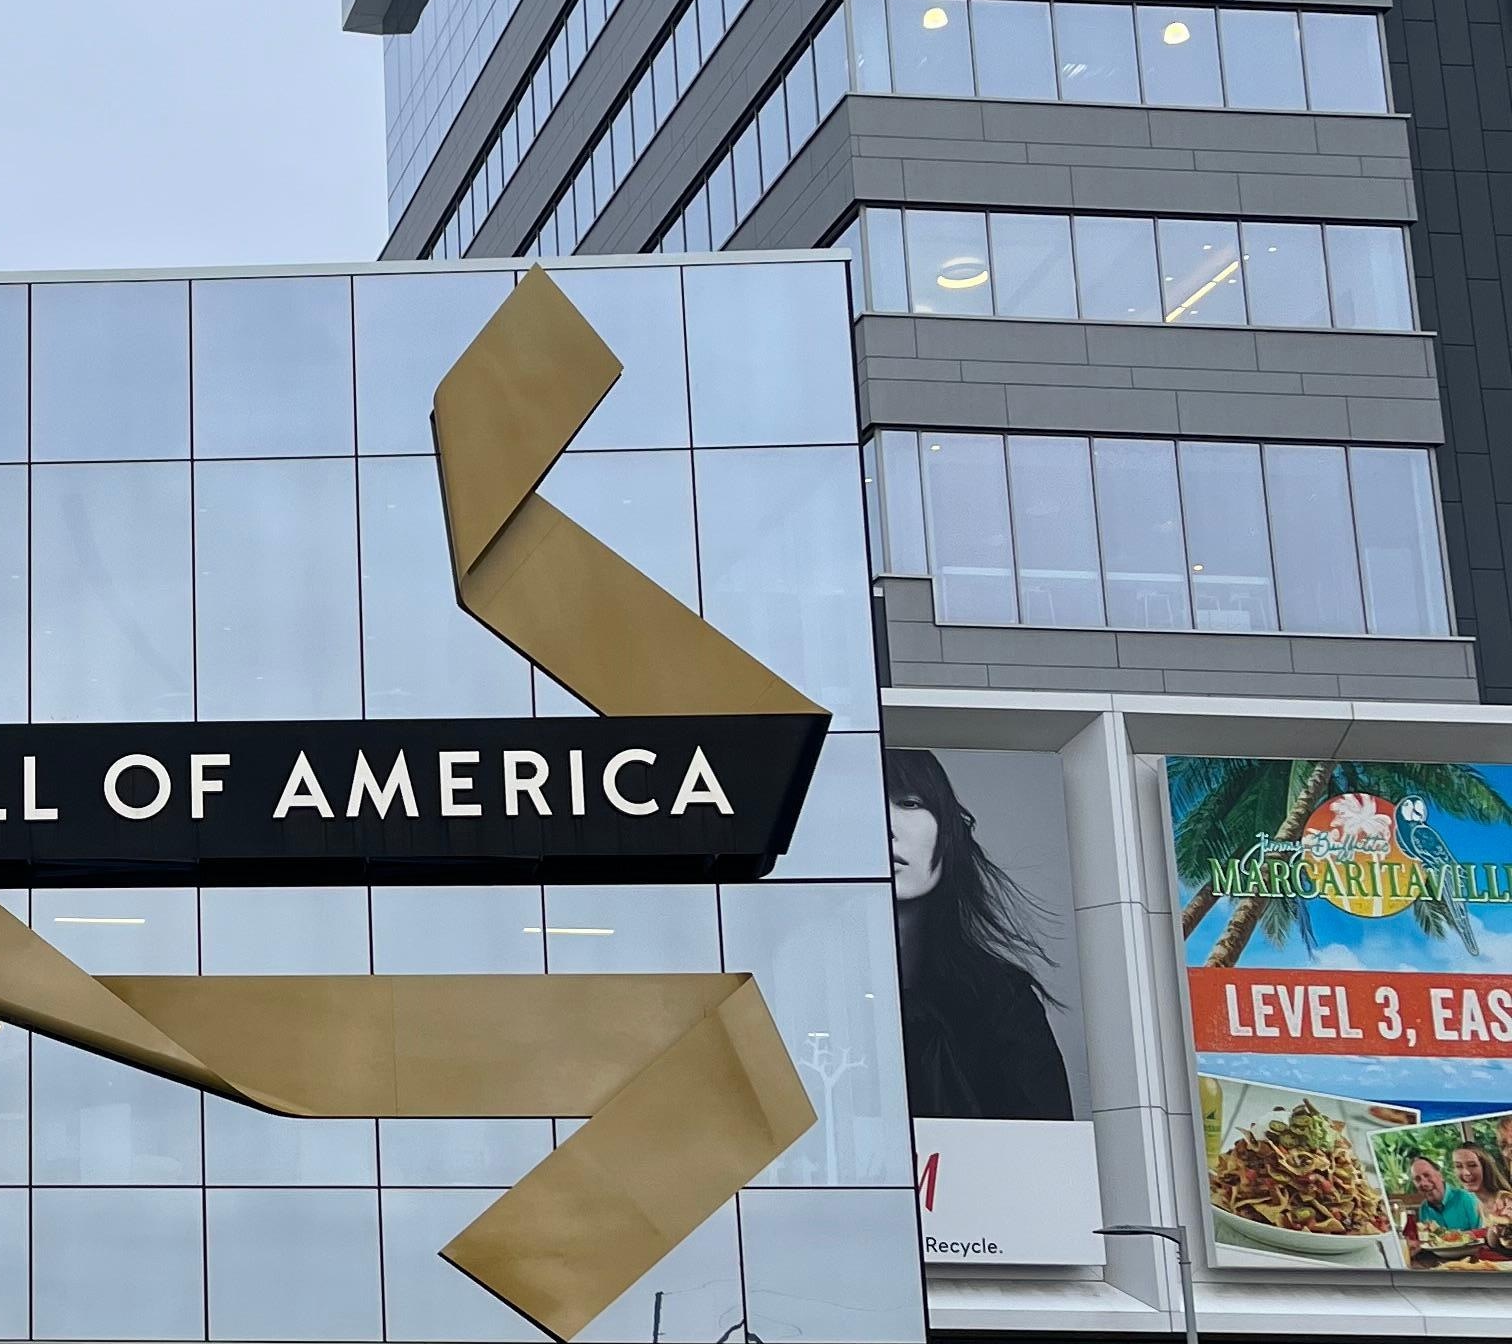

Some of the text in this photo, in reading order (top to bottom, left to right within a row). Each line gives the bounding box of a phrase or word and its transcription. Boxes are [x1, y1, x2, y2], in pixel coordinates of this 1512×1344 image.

[104, 753, 231, 820] OF
[272, 745, 735, 821] AMERICA
[1240, 831, 1304, 875] Jimmy
[1225, 984, 1364, 1039] LEVEL
[1374, 986, 1417, 1047] 3,
[925, 1236, 1004, 1258] Recycle.
